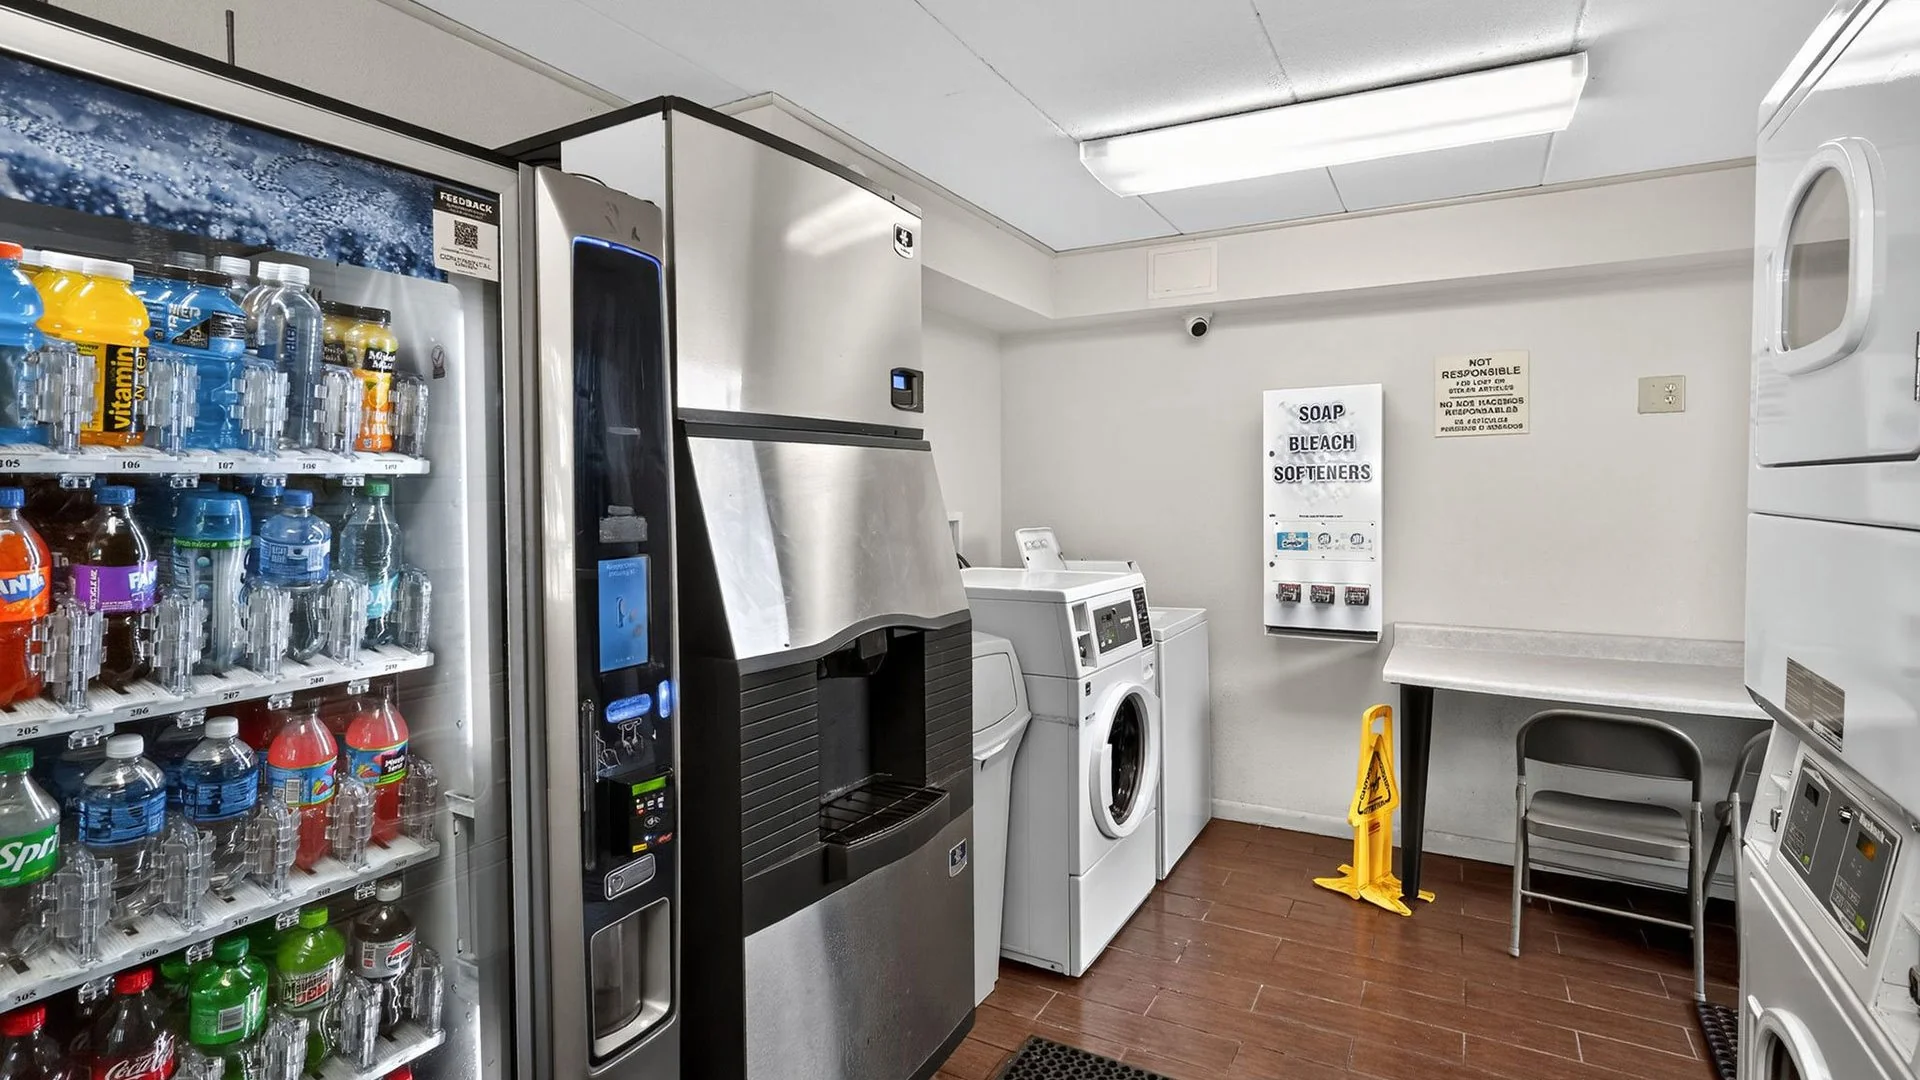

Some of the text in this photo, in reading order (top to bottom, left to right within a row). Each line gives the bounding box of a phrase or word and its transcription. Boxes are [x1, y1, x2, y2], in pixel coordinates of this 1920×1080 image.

[440, 191, 493, 214] FEEDBACK
[1469, 358, 1492, 367] NOT
[1441, 366, 1521, 379] RESPONSIBLE
[110, 347, 134, 429] vitamin
[1299, 404, 1344, 422] SOAP
[1289, 434, 1355, 452] BLEACH
[1274, 464, 1371, 482] SOFTENERS
[16, 725, 40, 737] 205
